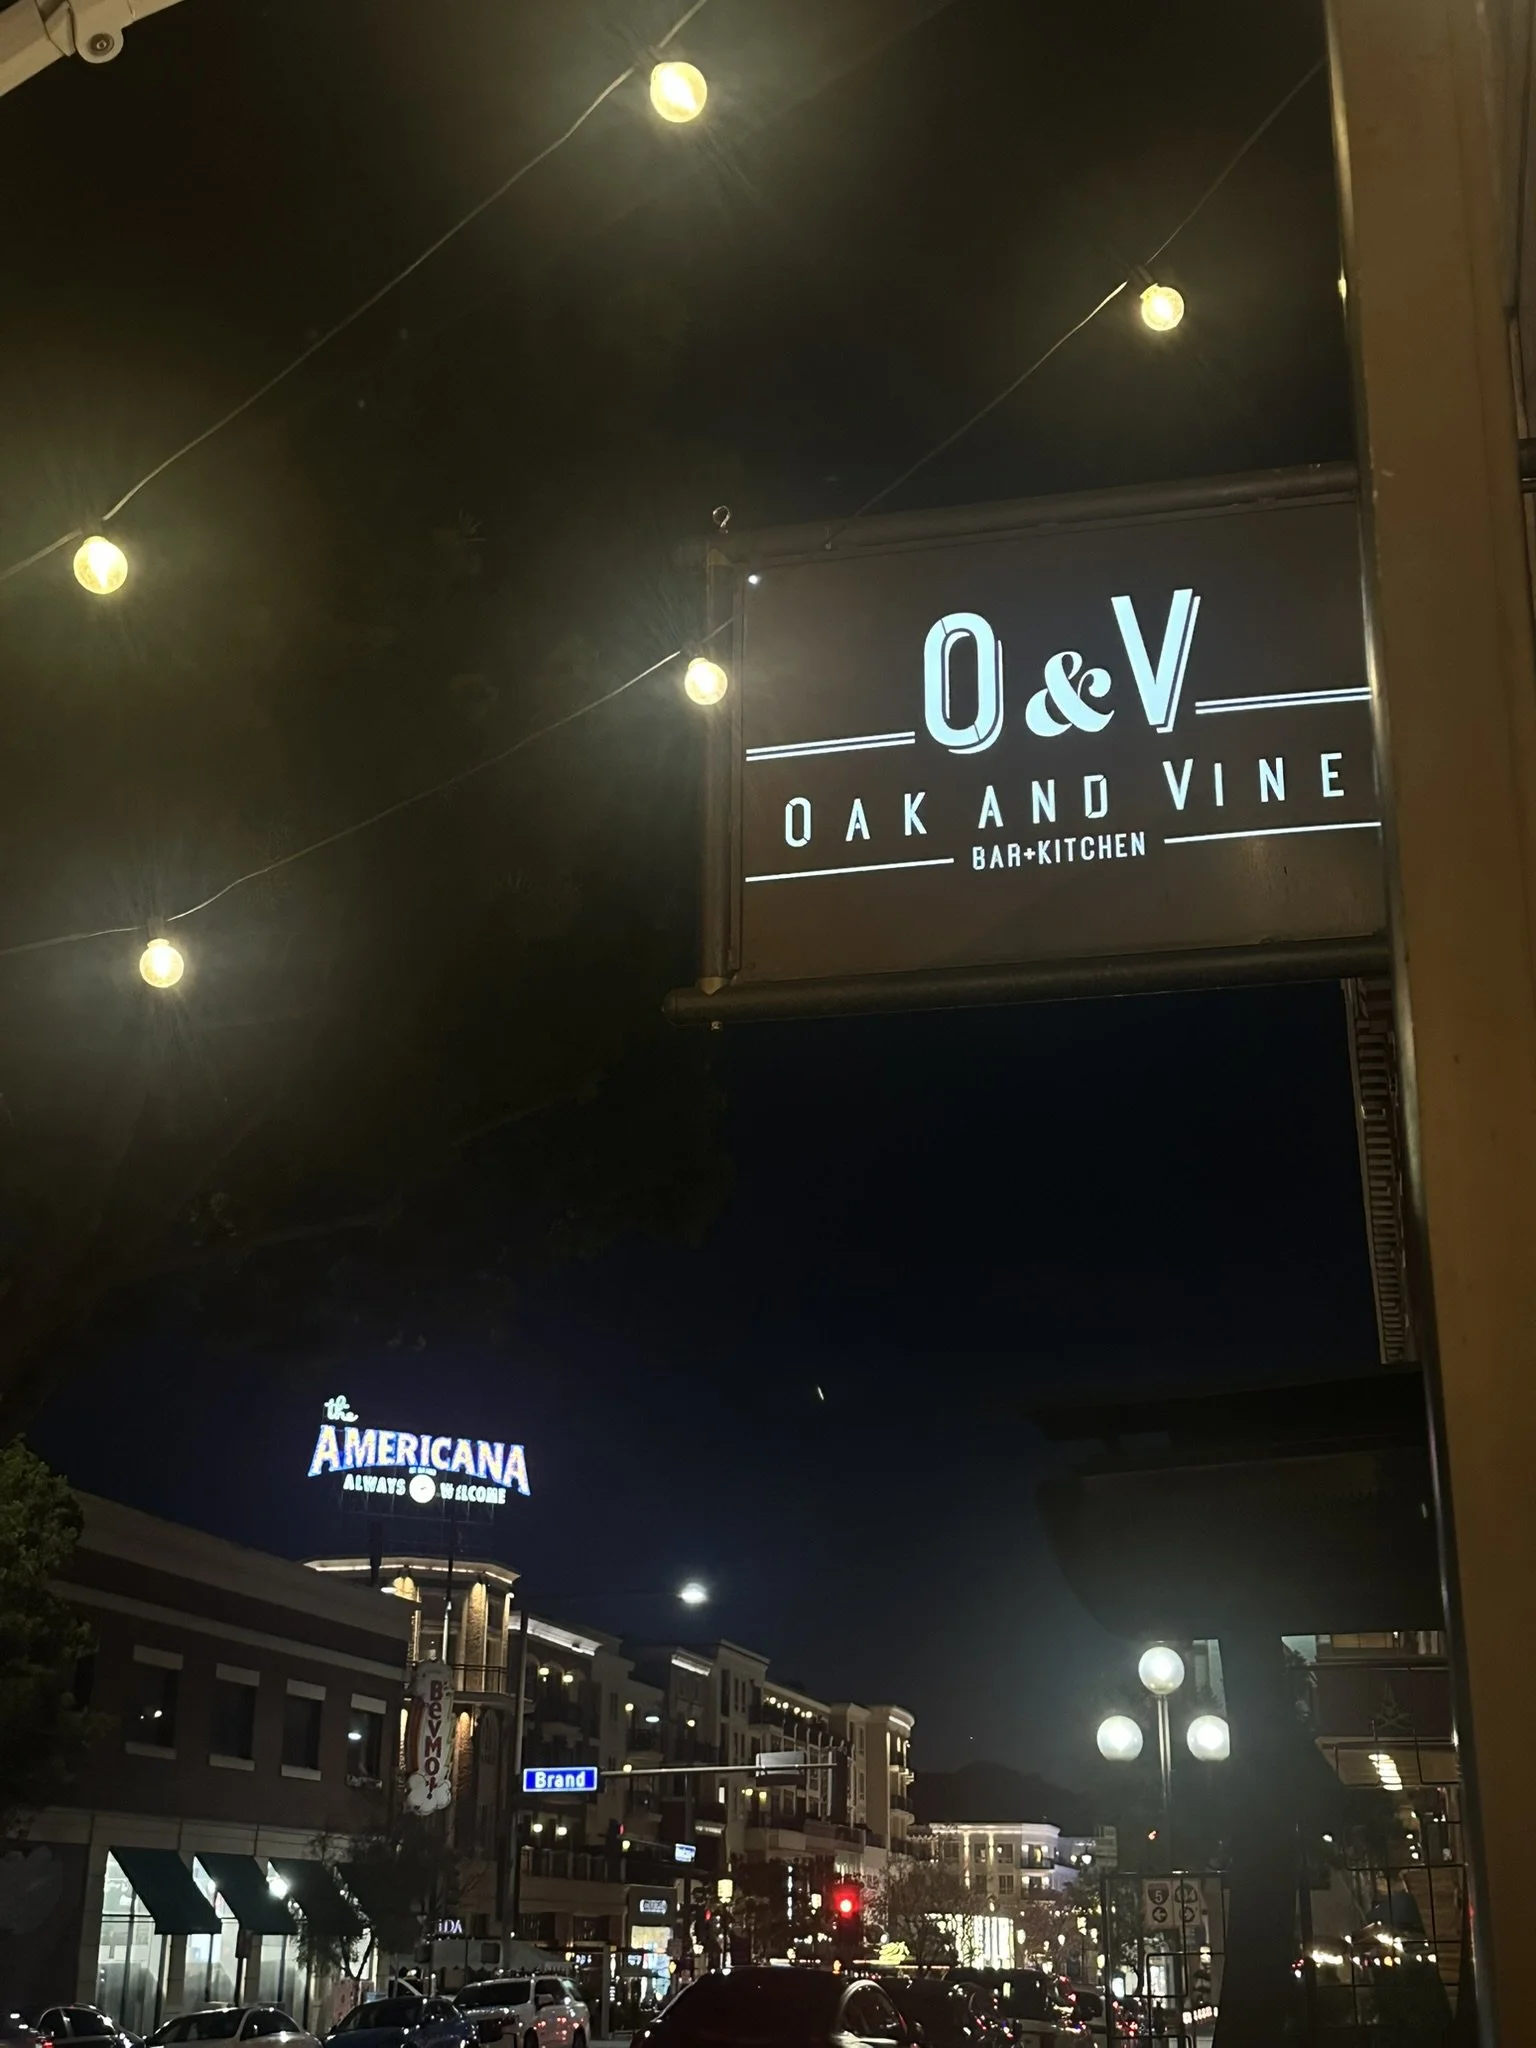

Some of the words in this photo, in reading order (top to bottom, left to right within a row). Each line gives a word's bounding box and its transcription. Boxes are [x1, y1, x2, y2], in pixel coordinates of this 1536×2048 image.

[785, 791, 927, 847] OAK
[978, 774, 1108, 829] AND
[1163, 752, 1344, 810] VINE
[972, 831, 1146, 870] BAR+KITCHEN
[324, 1394, 359, 1422] the
[307, 1424, 531, 1496] AMERICANA
[343, 1473, 406, 1496] ALWAYS
[439, 1482, 506, 1505] WELCOME
[534, 1771, 586, 1789] Brand
